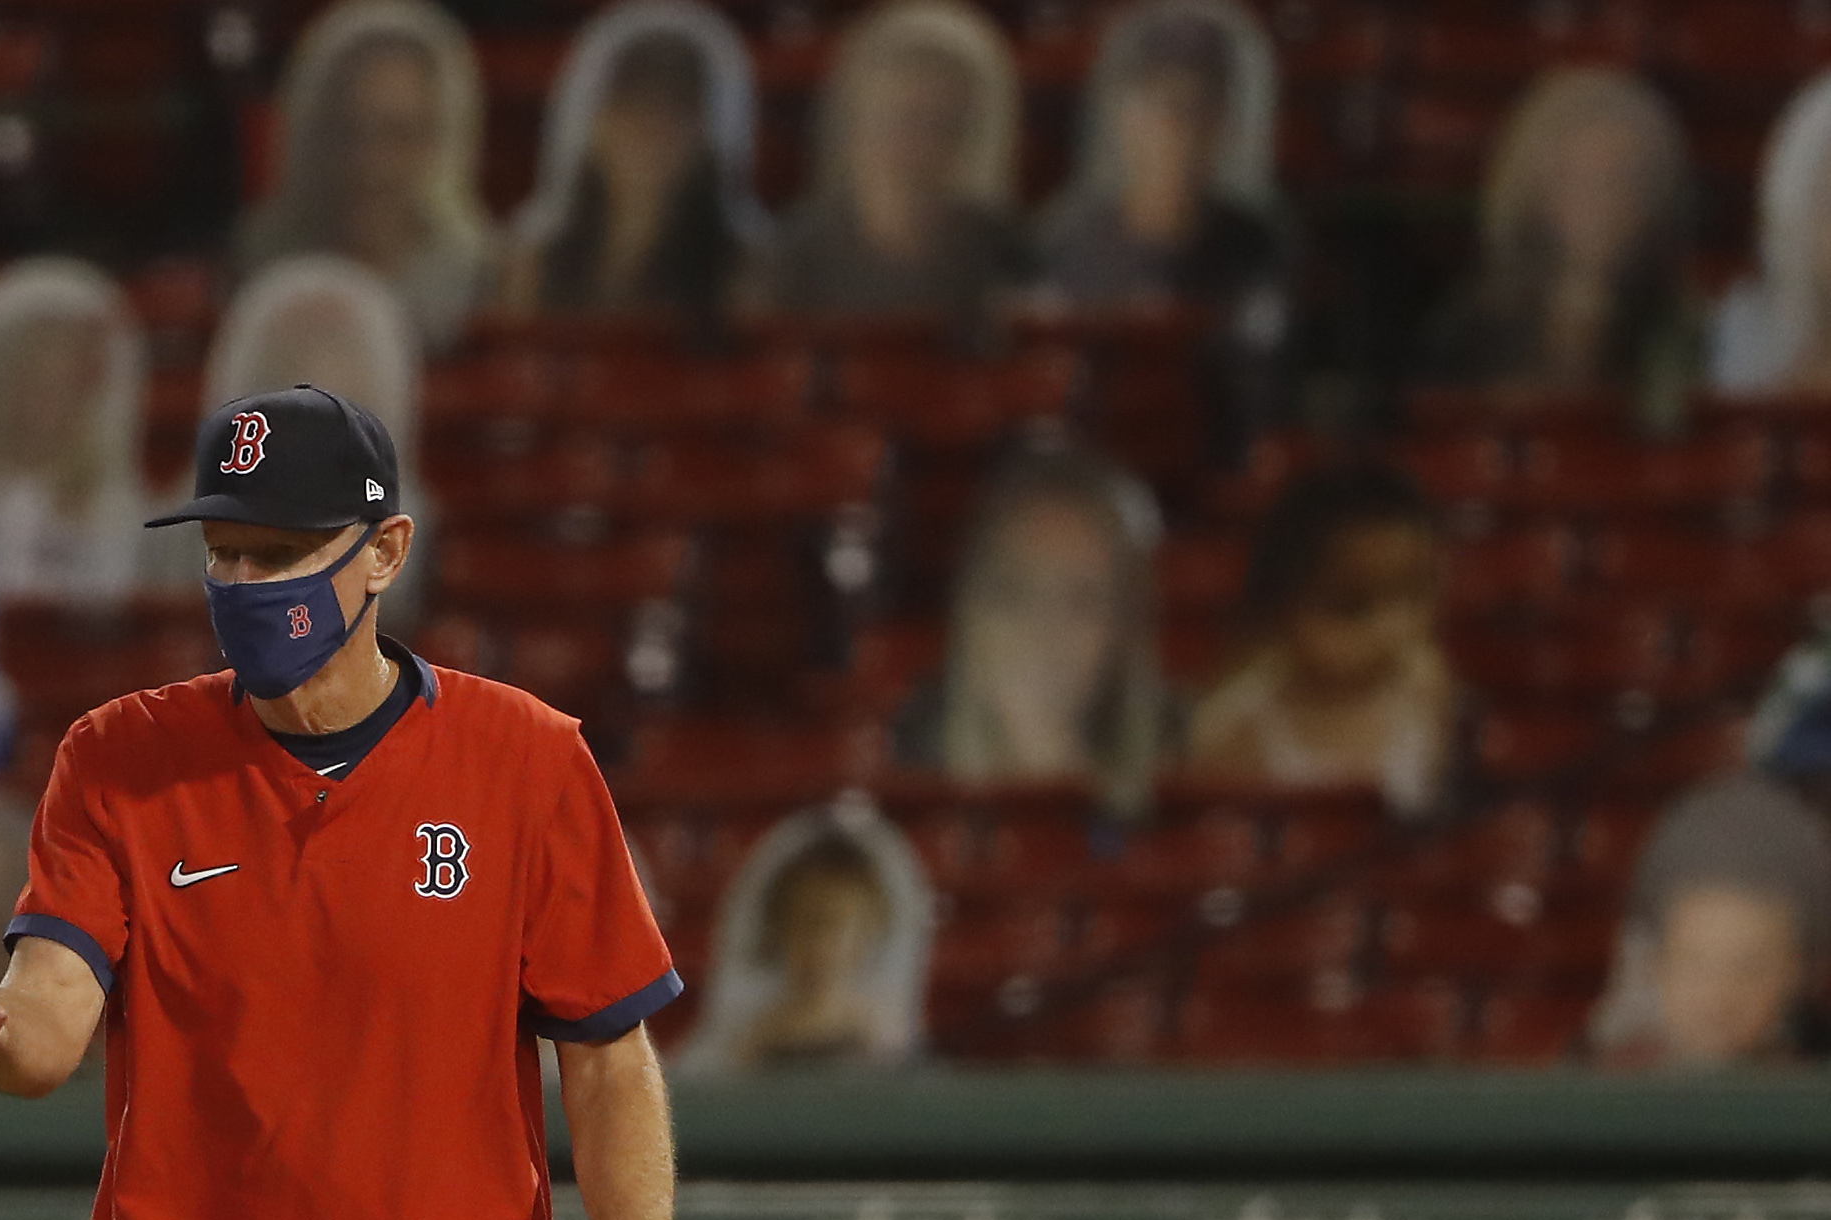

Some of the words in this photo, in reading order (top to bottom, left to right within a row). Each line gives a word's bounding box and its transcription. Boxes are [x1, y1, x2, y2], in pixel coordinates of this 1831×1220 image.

[220, 411, 271, 474] B
[287, 604, 313, 639] B
[414, 822, 471, 899] B
